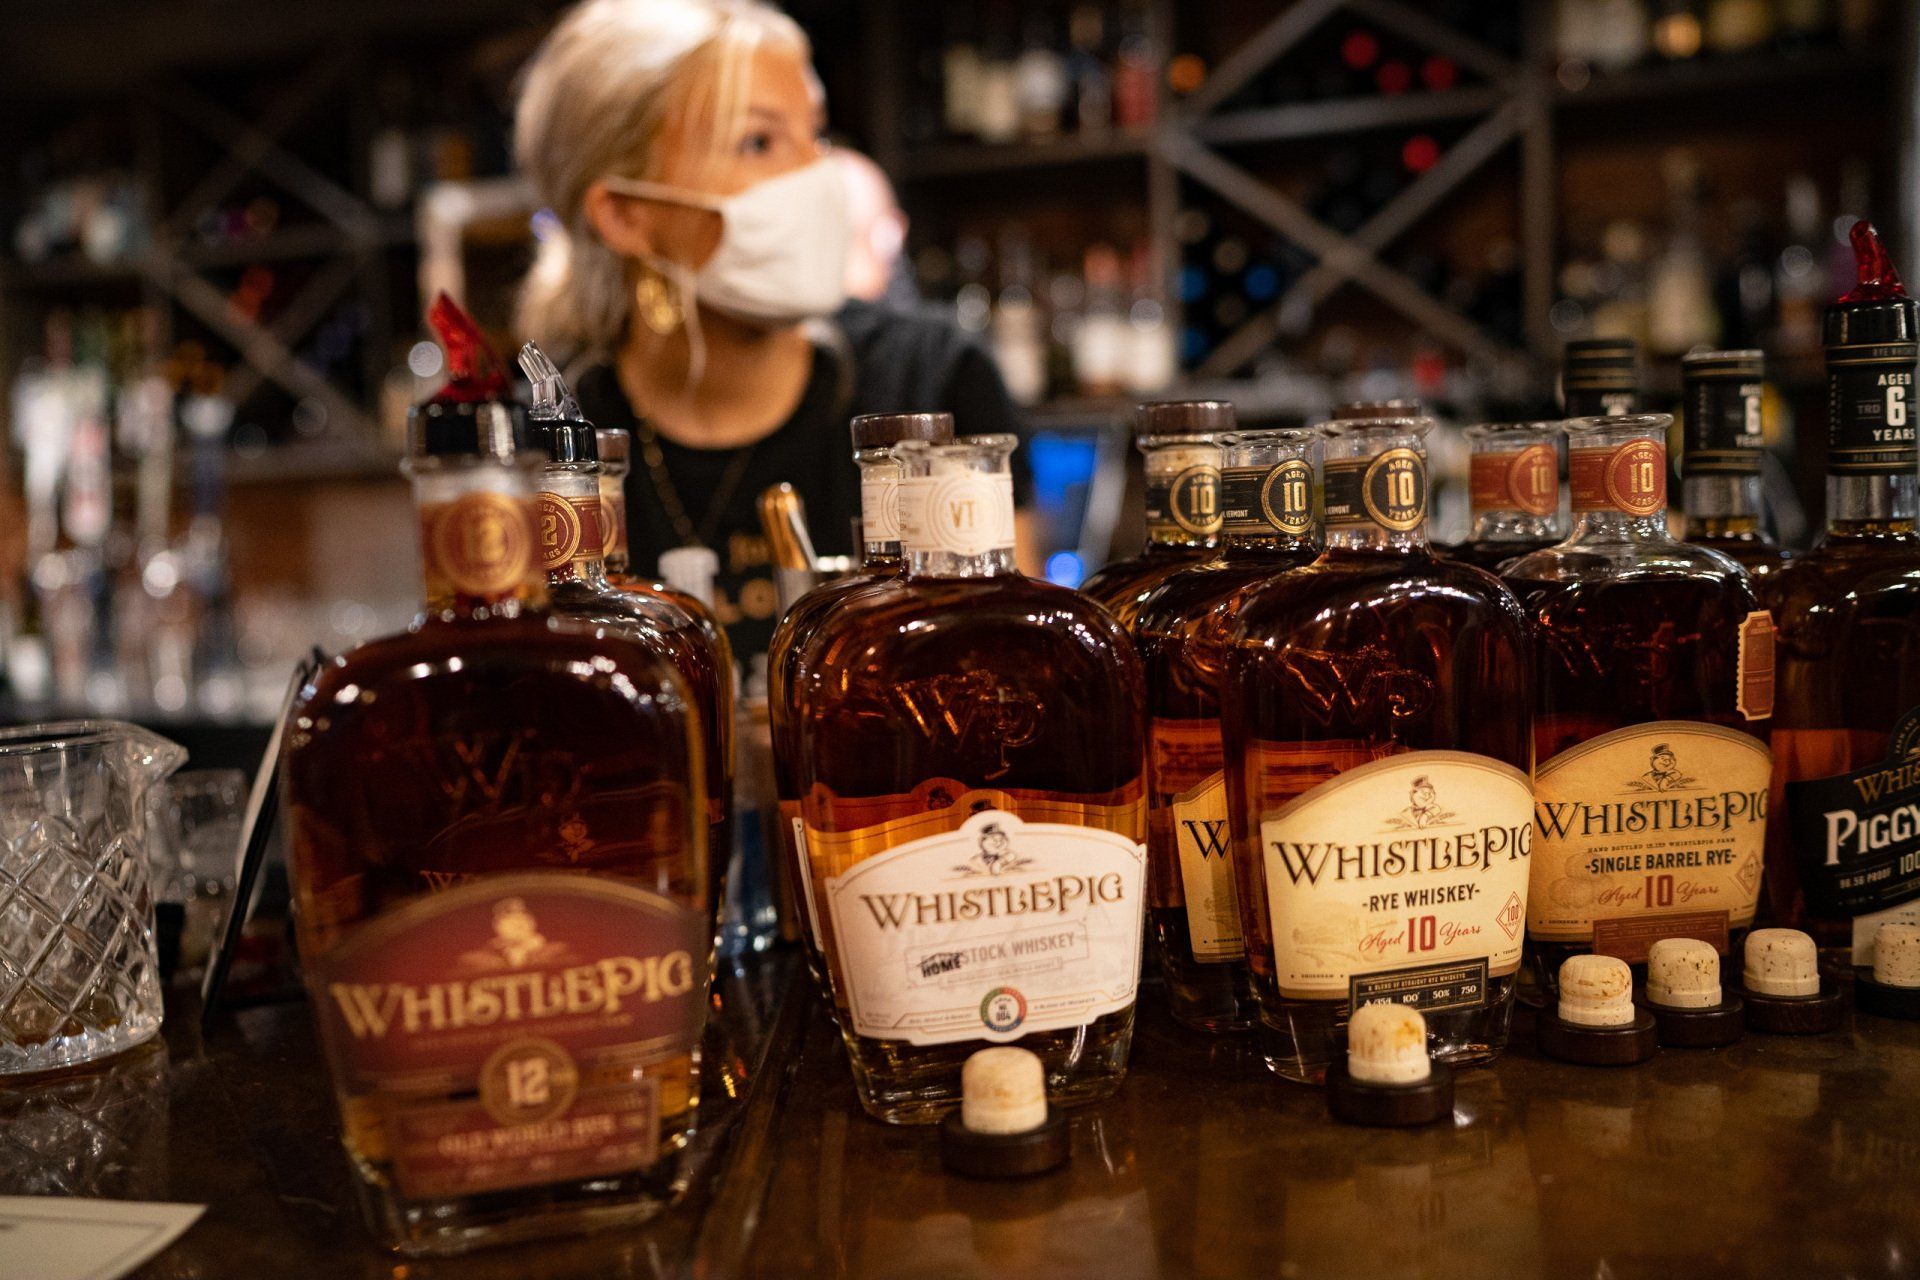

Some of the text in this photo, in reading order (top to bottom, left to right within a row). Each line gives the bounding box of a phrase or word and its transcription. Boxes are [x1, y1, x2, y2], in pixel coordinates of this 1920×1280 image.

[1878, 373, 1911, 385] AGED
[1886, 386, 1906, 426] 6
[1873, 428, 1915, 441] YEARS
[1285, 471, 1305, 480] AGED
[1386, 471, 1415, 507] 10
[1629, 462, 1655, 494] 10
[1189, 485, 1216, 515] 10
[1283, 482, 1306, 512] 10
[950, 500, 975, 529] VT
[540, 515, 557, 546] 2
[1271, 822, 1532, 889] WHISTLEPIG
[1646, 850, 1702, 869] BARREL
[861, 873, 1124, 931] WHISTLEPIG
[1598, 874, 1719, 908] Aged 10 Years
[1012, 932, 1076, 957] WHISKEY
[1358, 915, 1483, 953] Aged 10 Years
[330, 951, 693, 1038] WHISTLEPIG
[1401, 978, 1427, 988] STRAIGHT
[1440, 972, 1466, 982] WHISKEYS
[1432, 989, 1450, 1000] 50%
[1460, 985, 1477, 995] 750
[506, 1056, 550, 1107] 12
